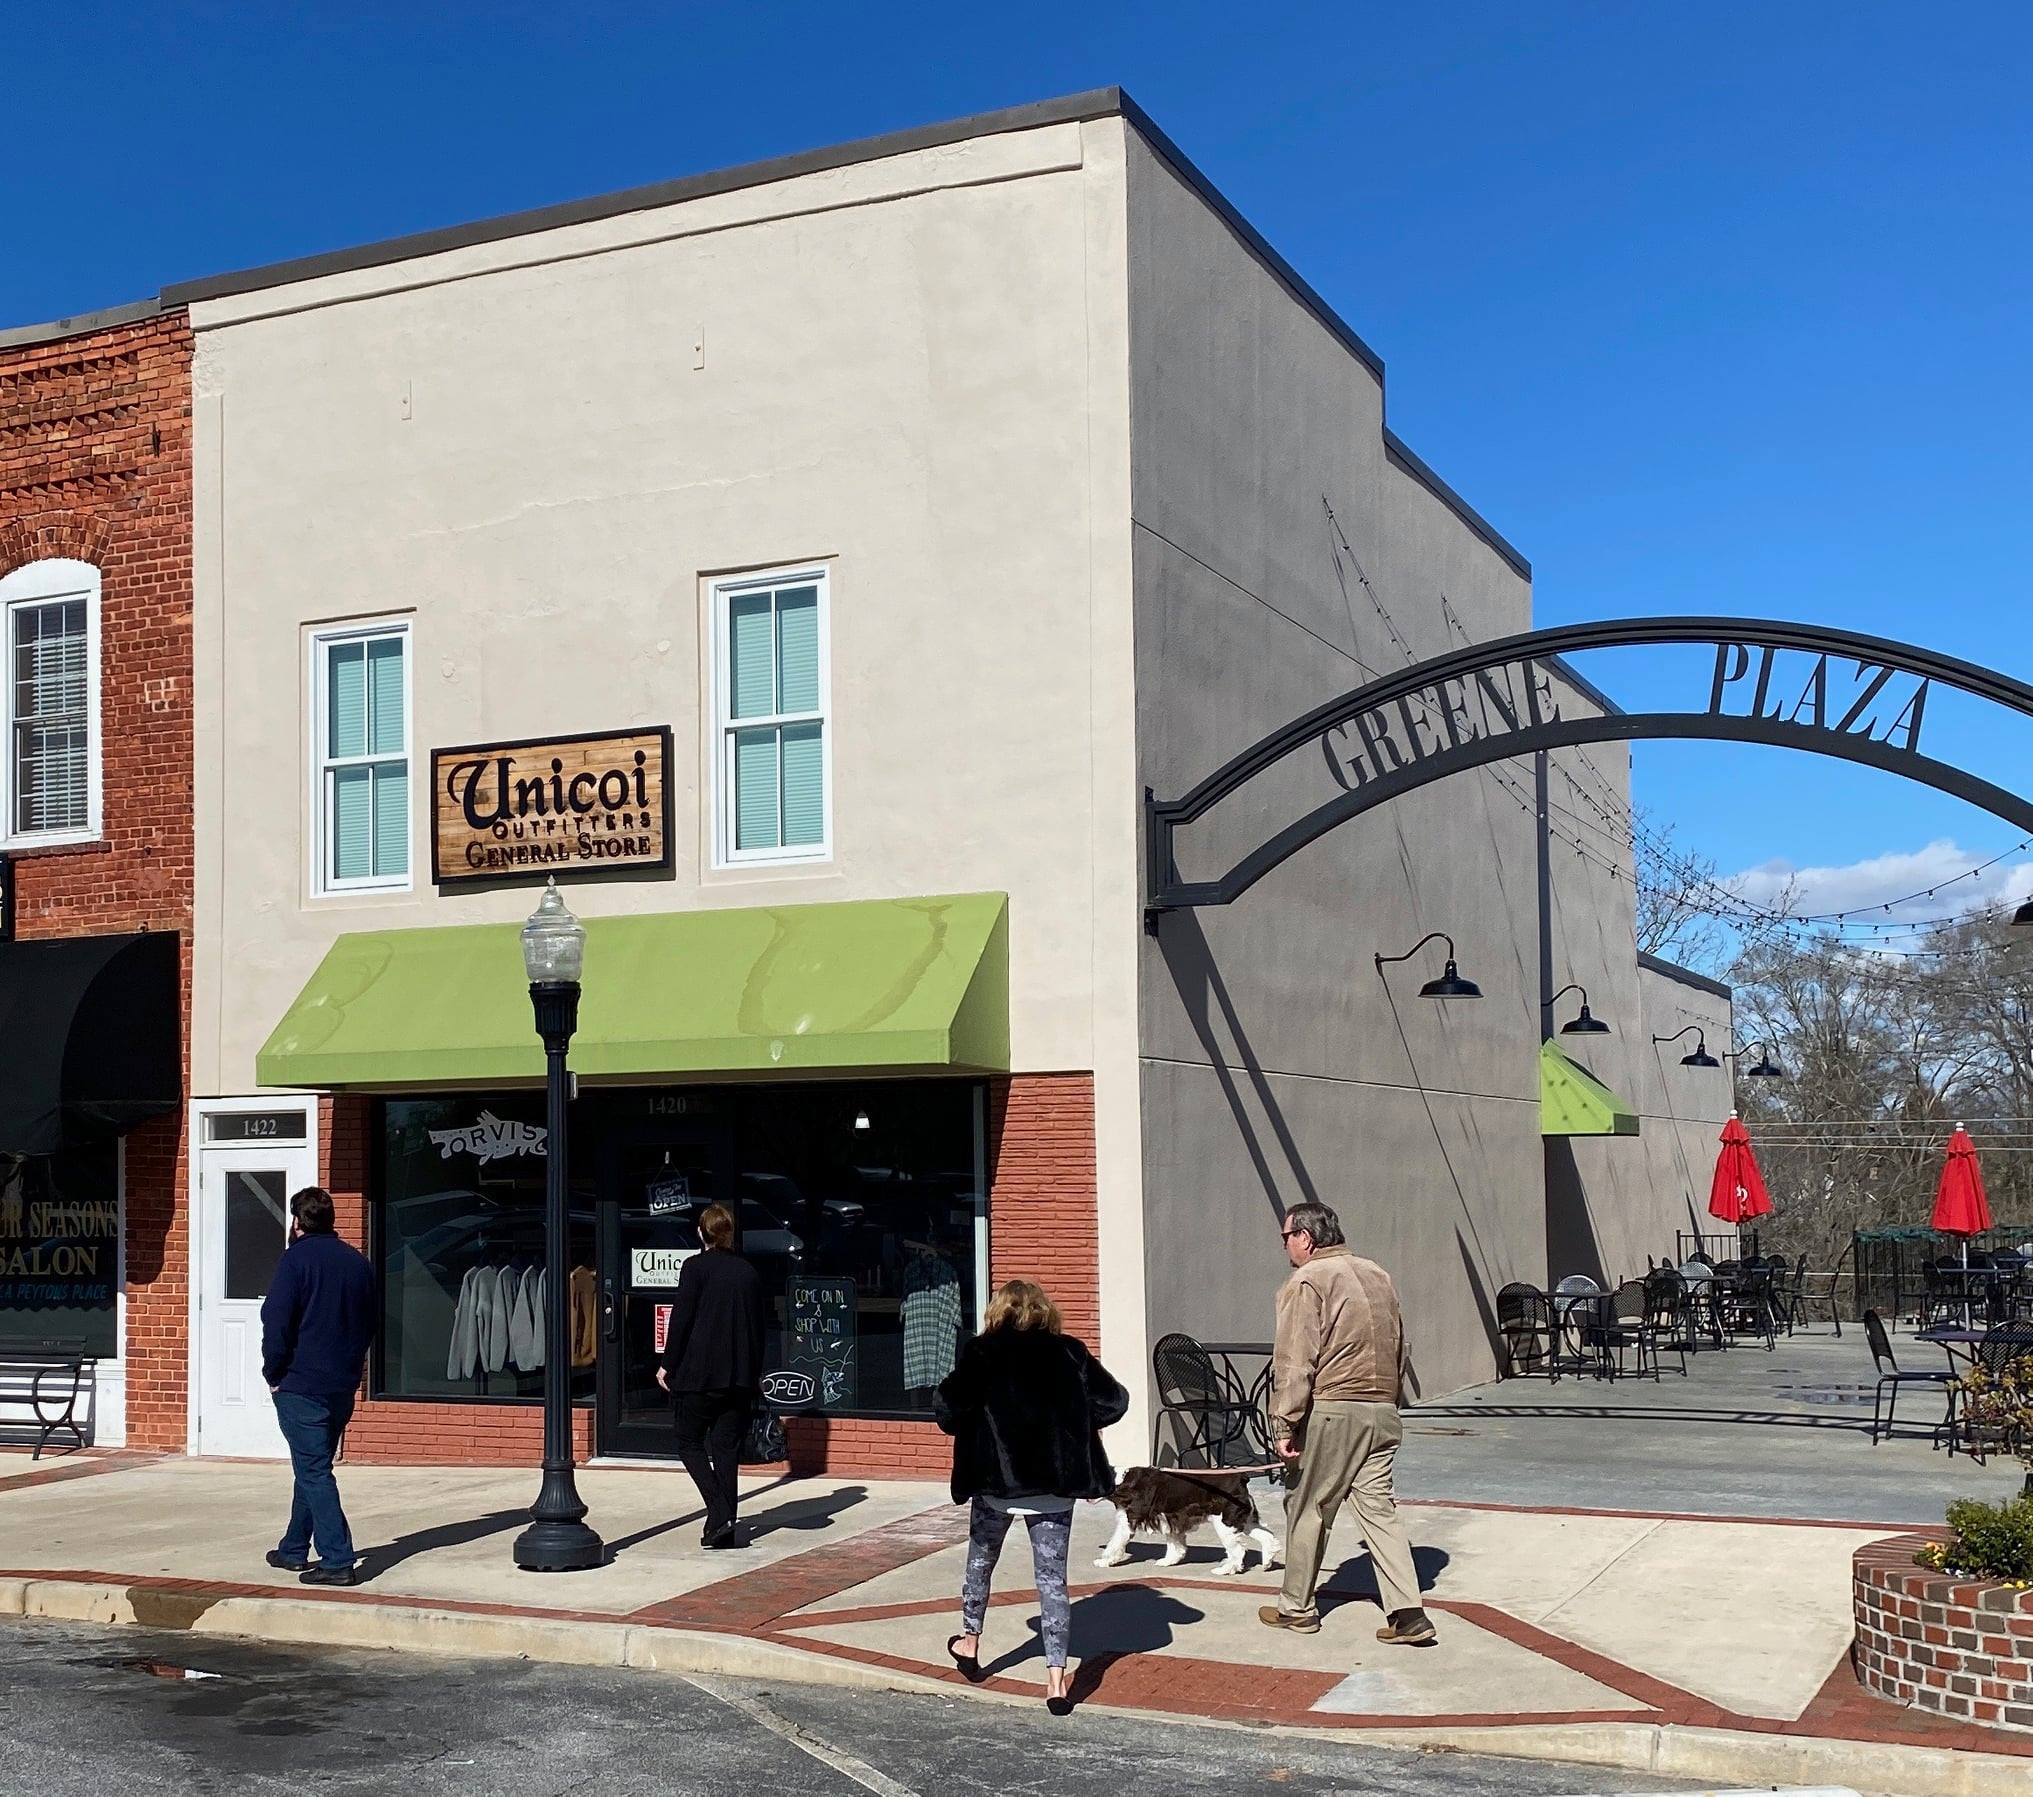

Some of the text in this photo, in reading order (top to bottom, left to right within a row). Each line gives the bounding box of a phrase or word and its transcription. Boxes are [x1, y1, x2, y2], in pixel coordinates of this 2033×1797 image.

[1321, 642, 1930, 791] GREENE PLAZA
[447, 750, 650, 830] Unicoi
[492, 811, 651, 840] OUTFITTERS
[465, 832, 651, 869] GENERAL STORE
[647, 1096, 687, 1114] 1420
[242, 1119, 277, 1136] 1422
[450, 1122, 537, 1154] ORVIS
[653, 1193, 686, 1209] OPEN
[30, 1201, 118, 1238] SEASONS
[635, 1251, 682, 1272] Unic
[72, 1284, 110, 1300] PLACE
[795, 1288, 845, 1304] COME ON IN
[813, 1303, 822, 1317] &
[795, 1317, 840, 1334] SHOP WITH
[810, 1338, 824, 1353] US
[763, 1378, 816, 1396] OPEN
